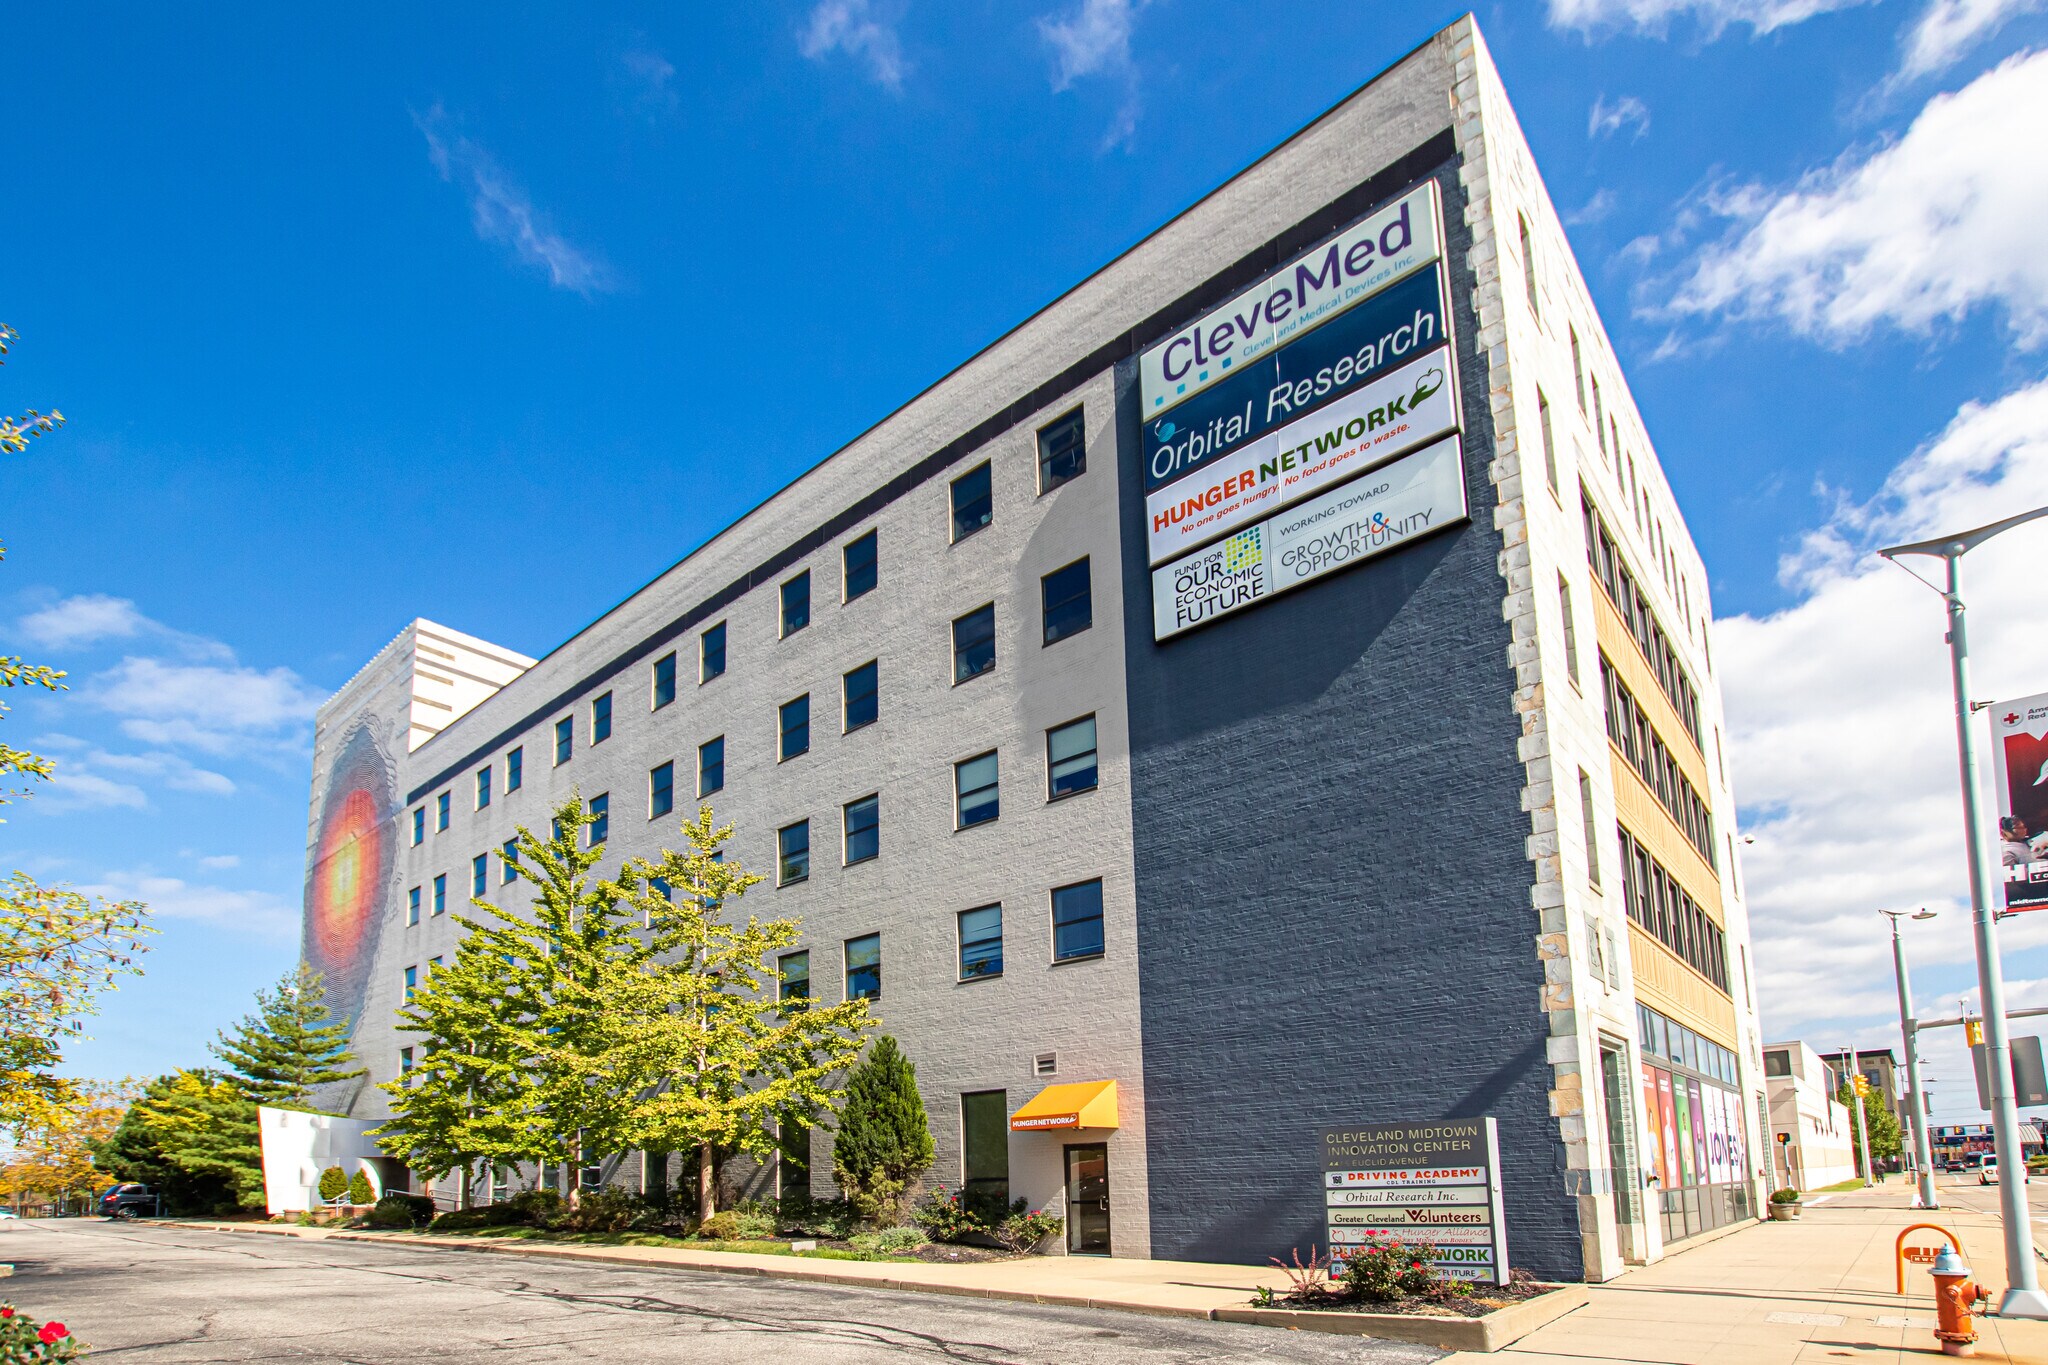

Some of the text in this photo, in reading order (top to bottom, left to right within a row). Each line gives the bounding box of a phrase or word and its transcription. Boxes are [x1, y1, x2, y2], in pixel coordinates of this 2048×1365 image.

[1163, 201, 1412, 382] CleveMed
[1243, 255, 1416, 356] Cleveland Medical Devices Inc.
[1151, 309, 1434, 479] Orbital Research
[1153, 395, 1408, 533] HUNGER NETWORK
[1181, 522, 1195, 535] No
[1197, 514, 1215, 528] one
[1216, 503, 1240, 522] goes
[1284, 473, 1300, 487] No
[1302, 460, 1327, 479] food
[1329, 447, 1356, 469] goes
[1359, 439, 1371, 452] to
[1373, 424, 1411, 445] waste.
[1280, 483, 1390, 537] WORKING TOWARD
[1295, 507, 1433, 577] OPPORTUNITY
[1174, 551, 1224, 577] FUND FOR
[1175, 562, 1225, 593] OUR
[1175, 563, 1264, 609] ECONOMIC
[1176, 578, 1265, 628] FUTURE
[2028, 712, 2046, 720] Red
[1326, 1126, 1478, 1144] CLEVELAND MIDTOWN
[1327, 1140, 1471, 1156] INNOVATION CENTER
[1347, 1168, 1479, 1181] DRIVING ACADEMY
[1352, 1158, 1387, 1167] EUCLID
[1388, 1157, 1429, 1165] AVENUE
[1346, 1190, 1459, 1202] Orbital Research Inc.
[1334, 1209, 1482, 1223] Greater Cleveland Volunteers
[1402, 1228, 1442, 1237] Hunger
[1443, 1227, 1488, 1237] Alliance
[1435, 1248, 1490, 1262] WORK
[1442, 1269, 1476, 1277] FUTURE
